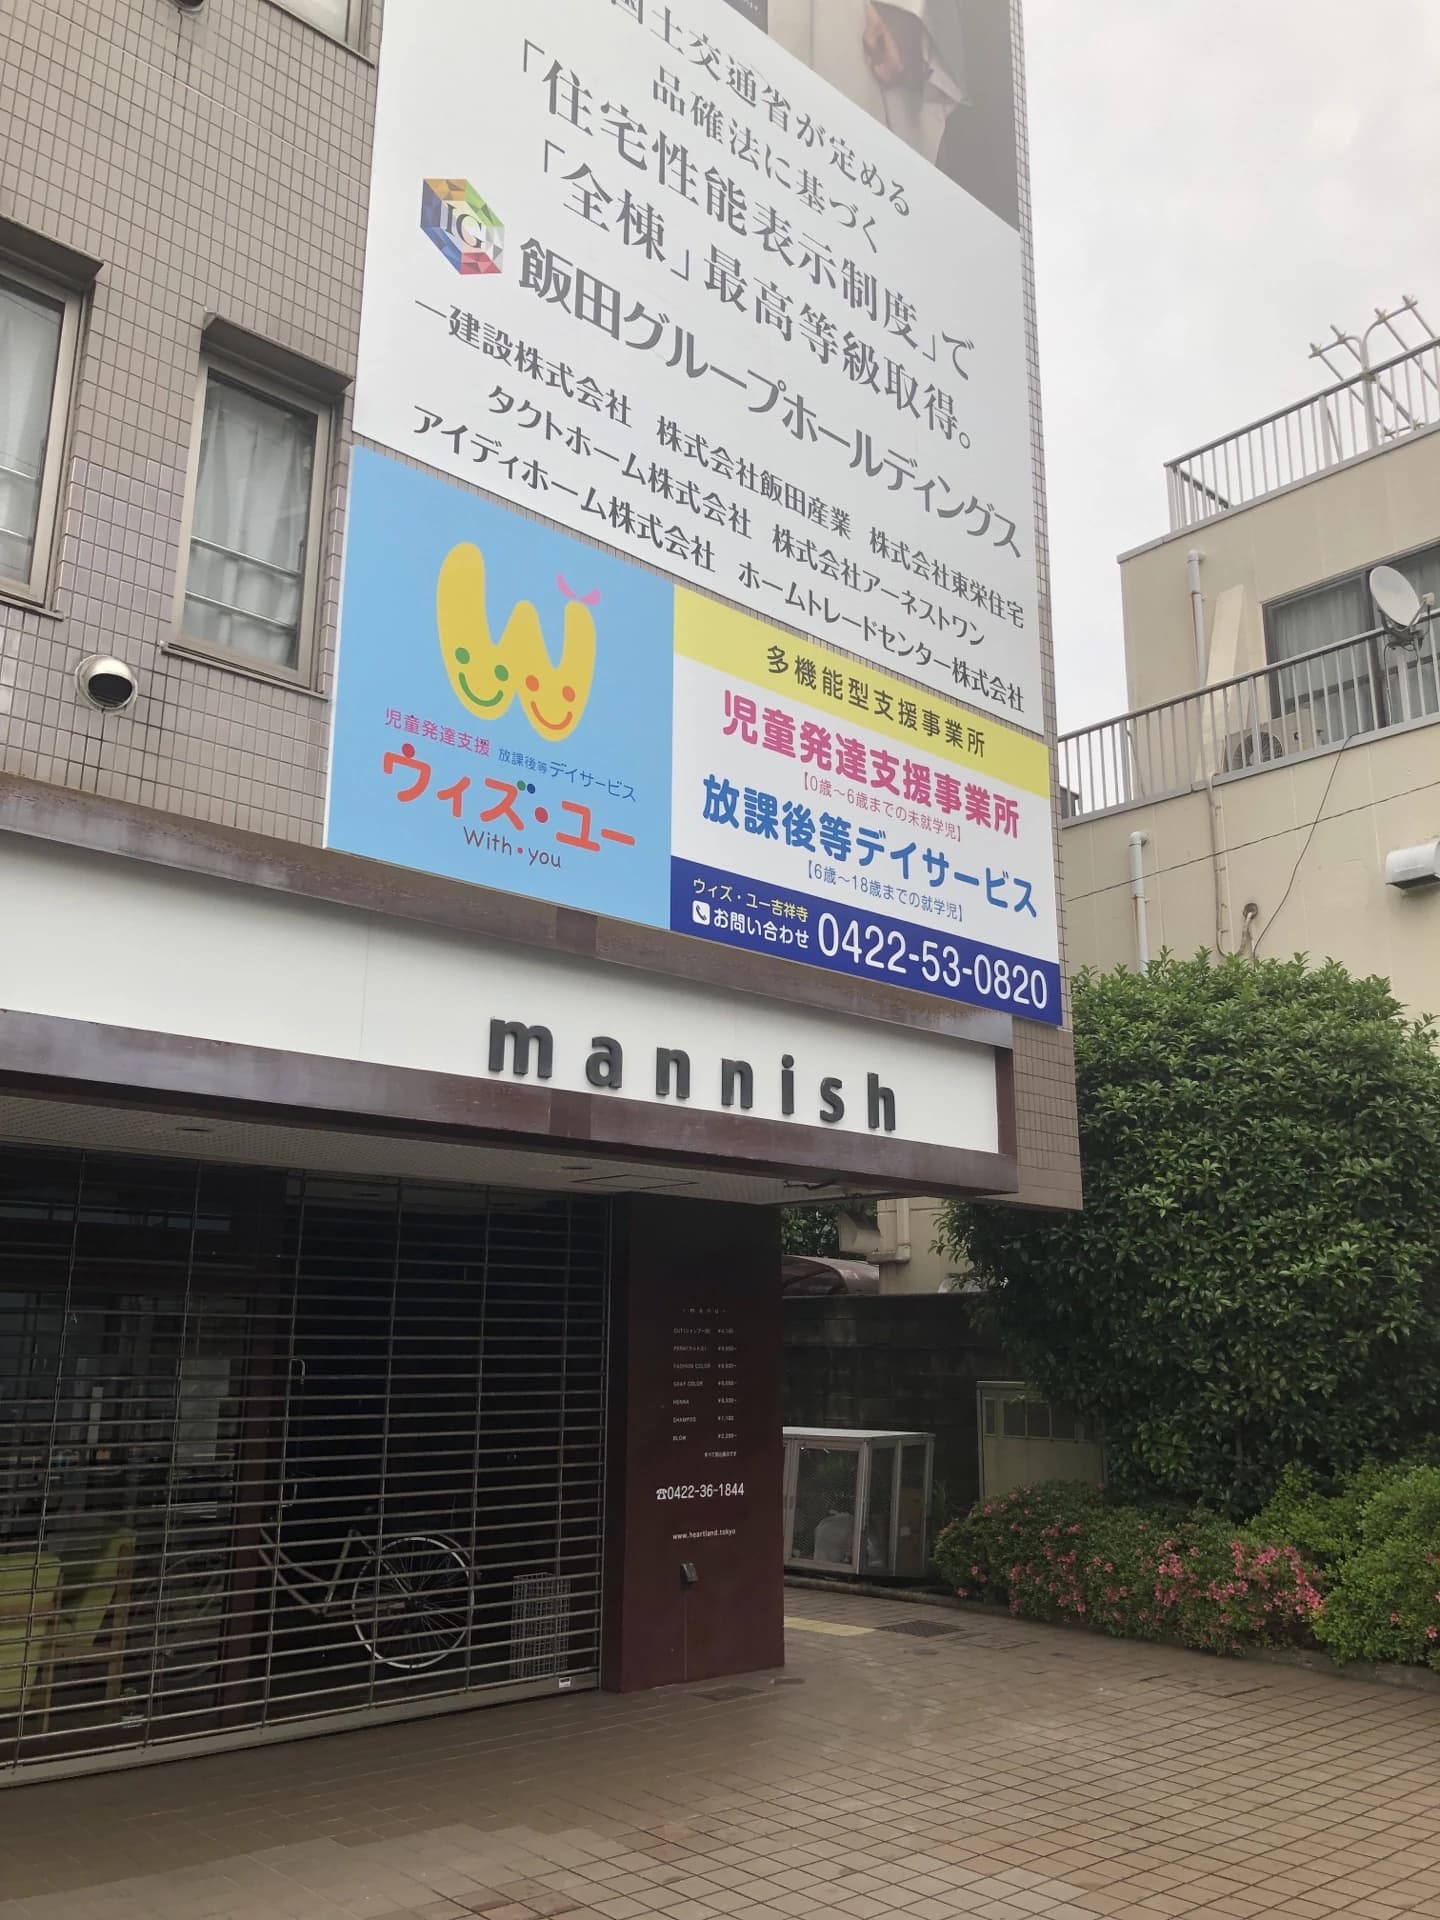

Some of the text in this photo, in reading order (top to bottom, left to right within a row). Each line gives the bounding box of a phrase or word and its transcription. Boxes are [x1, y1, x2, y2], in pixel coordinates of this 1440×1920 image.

[523, 38, 976, 381] 「住宅性能表示制度」で
[652, 64, 878, 254] 品確法に基づく
[543, 139, 972, 449] 「全棟」最高等級取得。
[414, 299, 1024, 629] 一建設株式会社 株式会社飯田産業 株式会社東栄住宅
[517, 237, 1022, 558] 飯田グループホールディングス
[413, 405, 1025, 713] アイディホーム株式会社 ホームトレードセンター株式会社
[488, 385, 986, 646] タクトホーム株式会社 株式会社アーネストワン
[384, 707, 636, 802] 児童発達支援 放課後等デイサービス
[722, 689, 1019, 839] 児童発達支援事業所
[766, 645, 985, 758] 多機能型支援事業所
[702, 773, 1037, 918] 放課後等デイサービス
[712, 907, 809, 949] お問い合わせ
[818, 912, 1048, 1010] 0422-53-0820
[488, 1016, 897, 1131] mannish
[667, 1482, 745, 1500] 0422-36-1844
